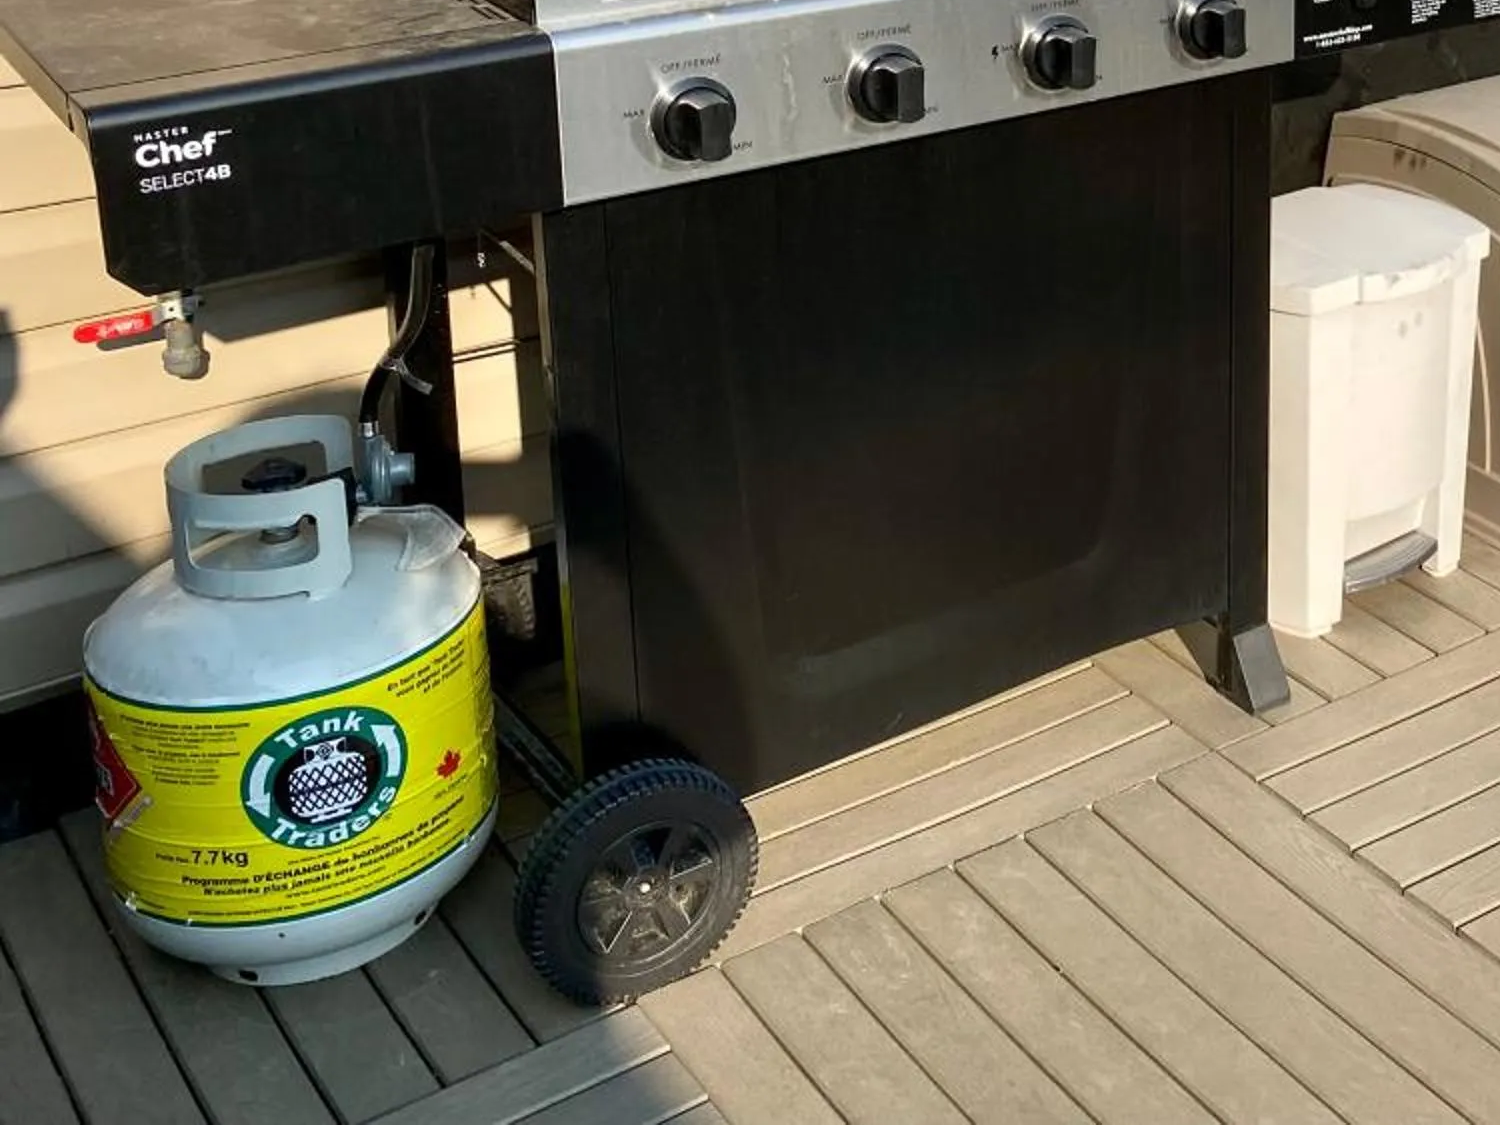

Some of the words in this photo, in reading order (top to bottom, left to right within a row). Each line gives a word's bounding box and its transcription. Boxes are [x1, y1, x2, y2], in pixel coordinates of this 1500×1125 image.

[133, 126, 189, 143] MASTER
[135, 131, 218, 168] Chef
[274, 710, 365, 749] Tank
[271, 786, 397, 849] Traders
[182, 875, 249, 887] Programme
